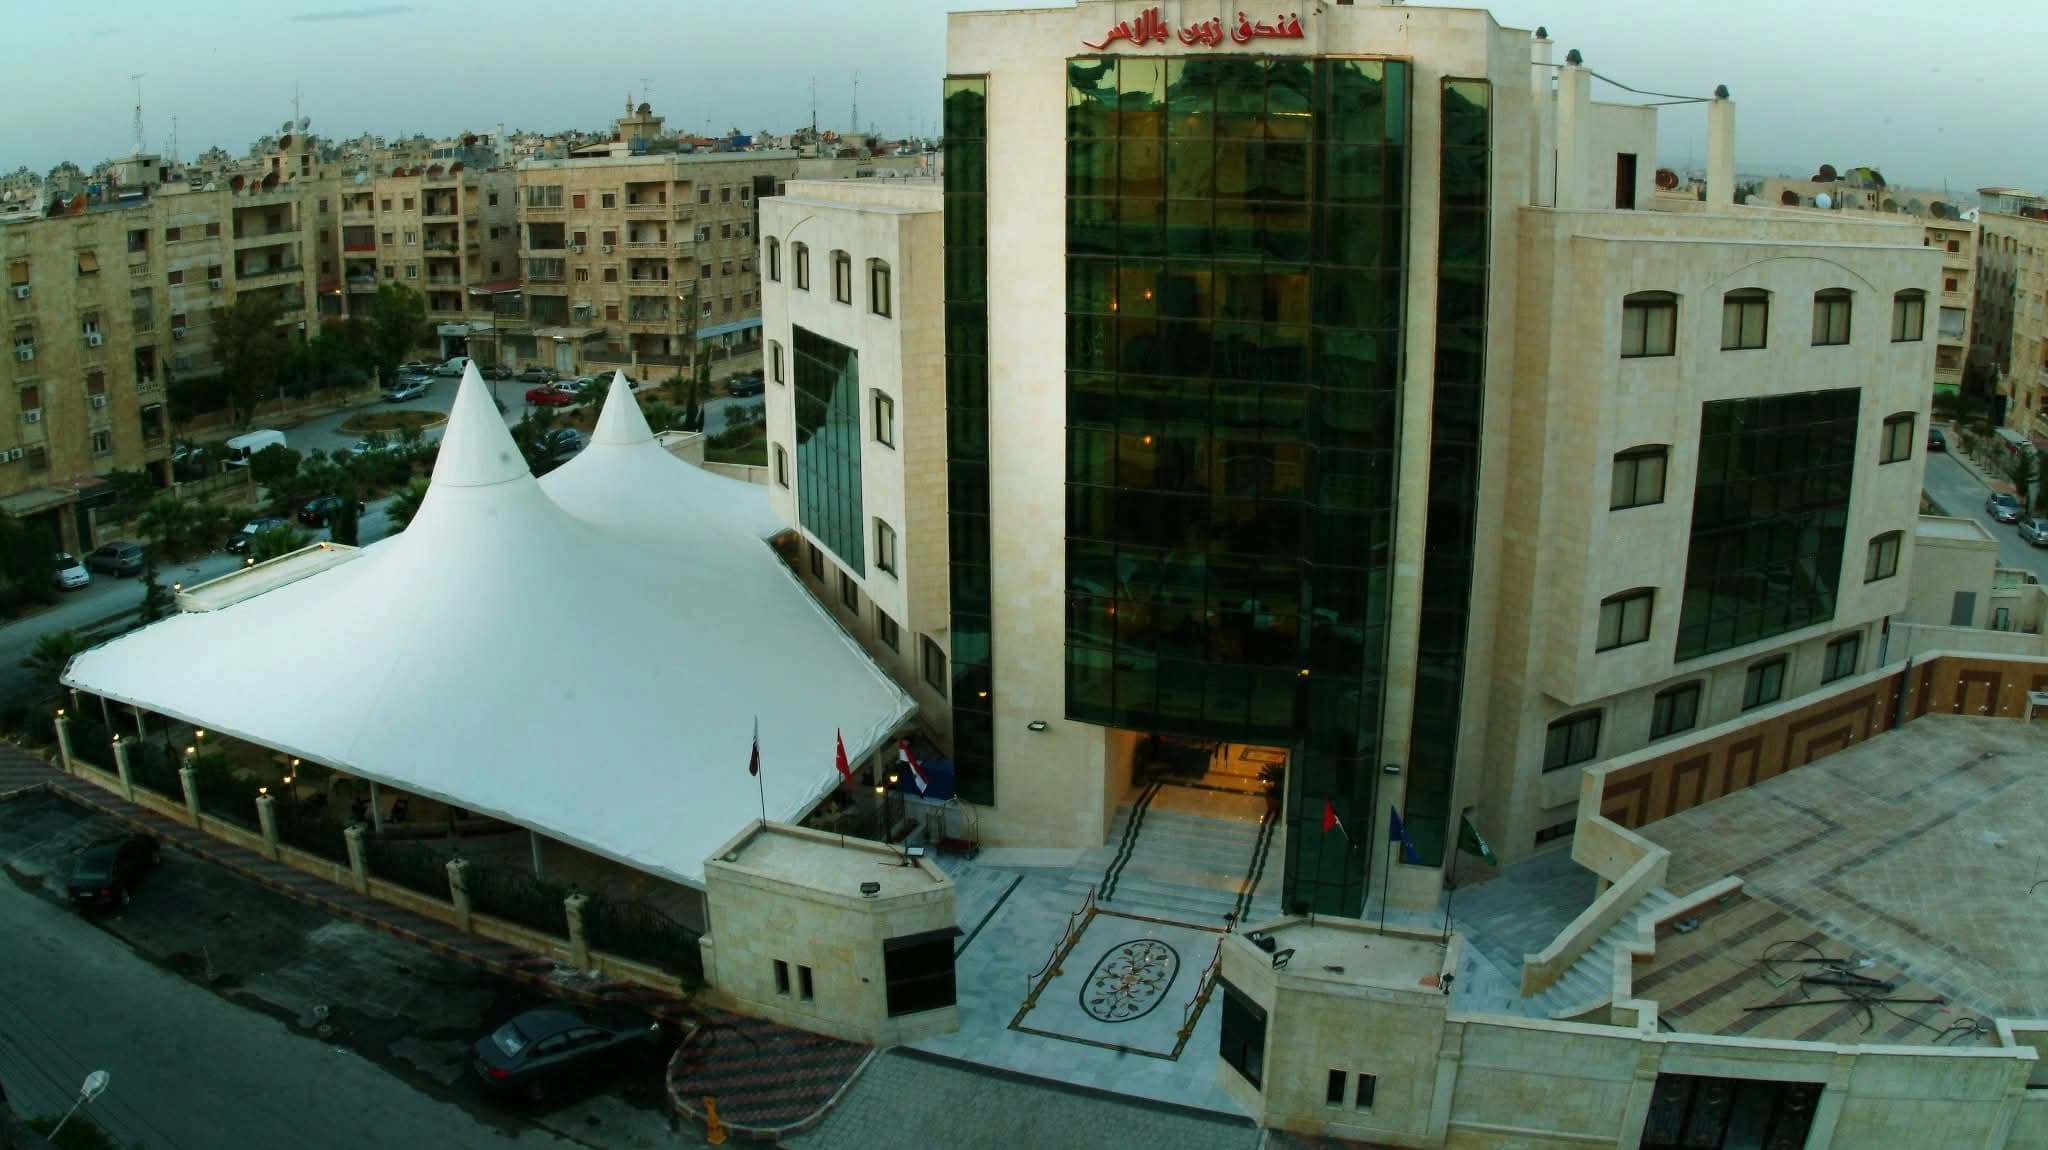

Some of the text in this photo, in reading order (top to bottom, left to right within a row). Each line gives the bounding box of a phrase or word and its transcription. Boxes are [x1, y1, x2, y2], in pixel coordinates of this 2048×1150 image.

[1082, 6, 1304, 50] فندق زين بالاس
